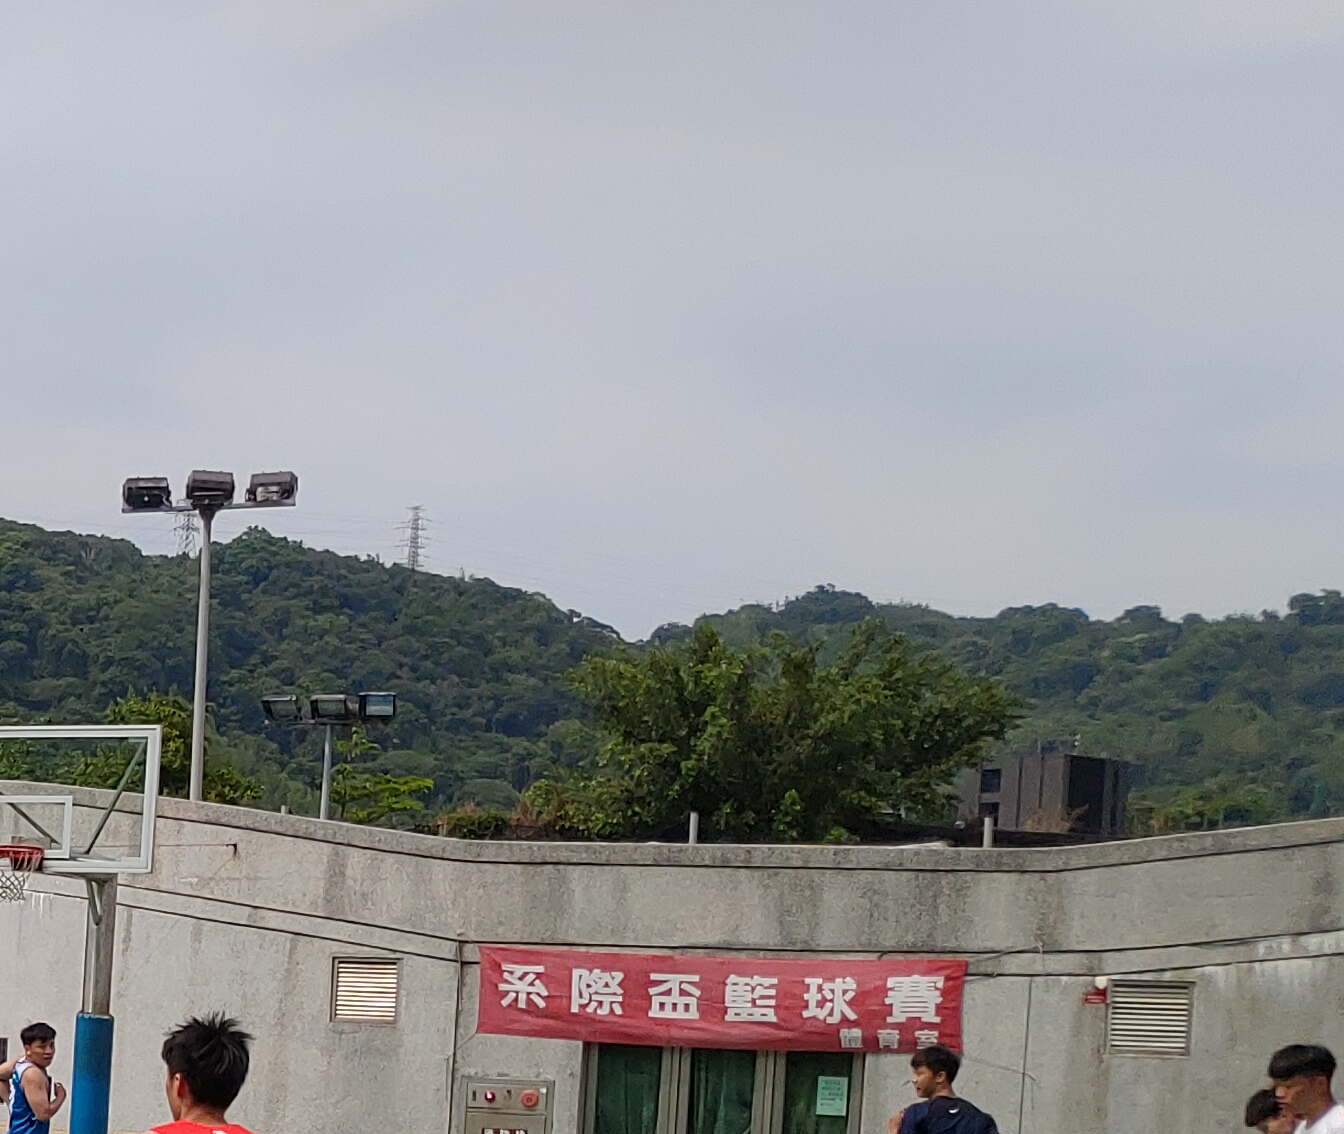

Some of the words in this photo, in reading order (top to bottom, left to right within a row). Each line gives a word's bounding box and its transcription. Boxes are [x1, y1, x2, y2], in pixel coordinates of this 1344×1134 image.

[498, 964, 945, 1025] 系際盃籃球賽
[839, 1028, 939, 1050] 體育室
